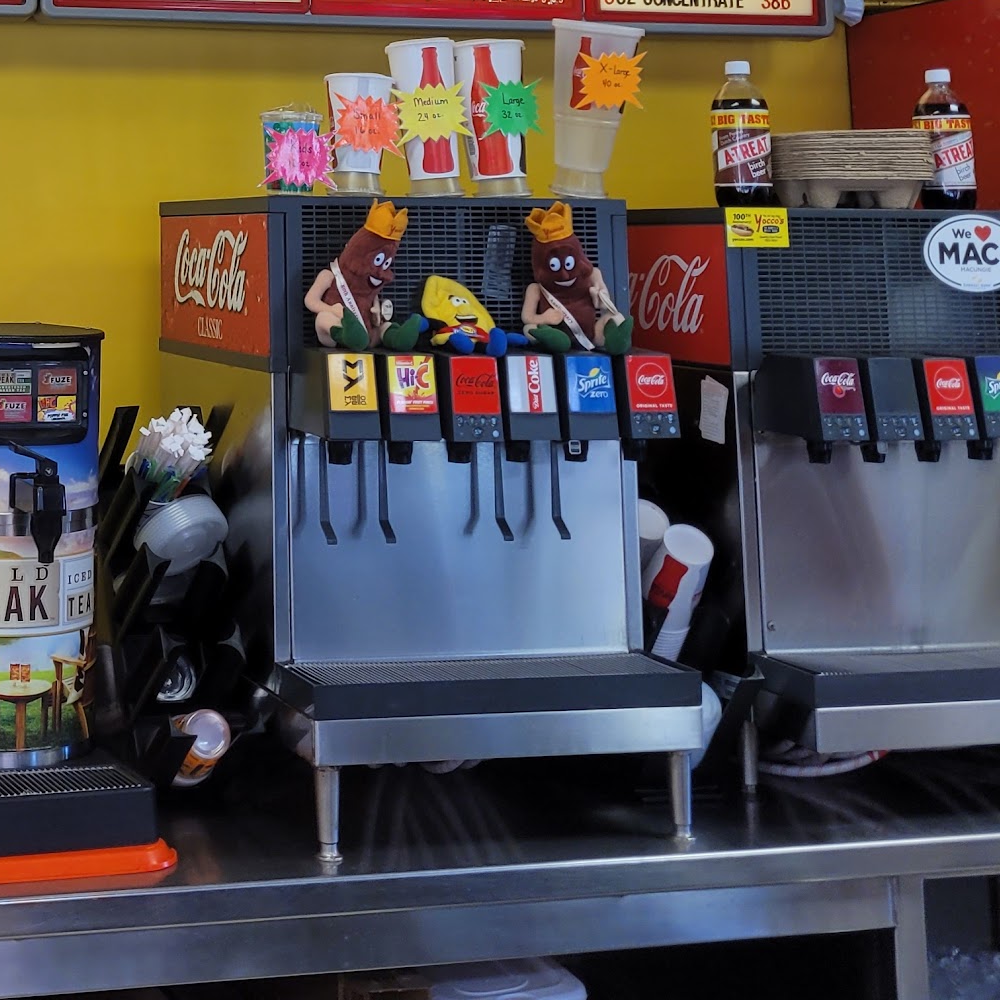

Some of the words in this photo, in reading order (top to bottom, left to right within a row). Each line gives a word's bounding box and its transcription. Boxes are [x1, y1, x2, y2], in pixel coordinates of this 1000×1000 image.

[414, 97, 448, 106] Medium
[502, 93, 524, 106] Large
[502, 110, 512, 118] 32
[718, 115, 735, 125] BIG
[748, 159, 765, 170] birch
[752, 169, 766, 178] beer
[952, 229, 971, 238] We
[939, 242, 999, 265] MAC
[198, 317, 223, 340] CLASSIC
[528, 359, 540, 393] Coke
[578, 374, 607, 392] Sprite
[68, 569, 91, 584] ICED
[68, 595, 91, 616] TEA
